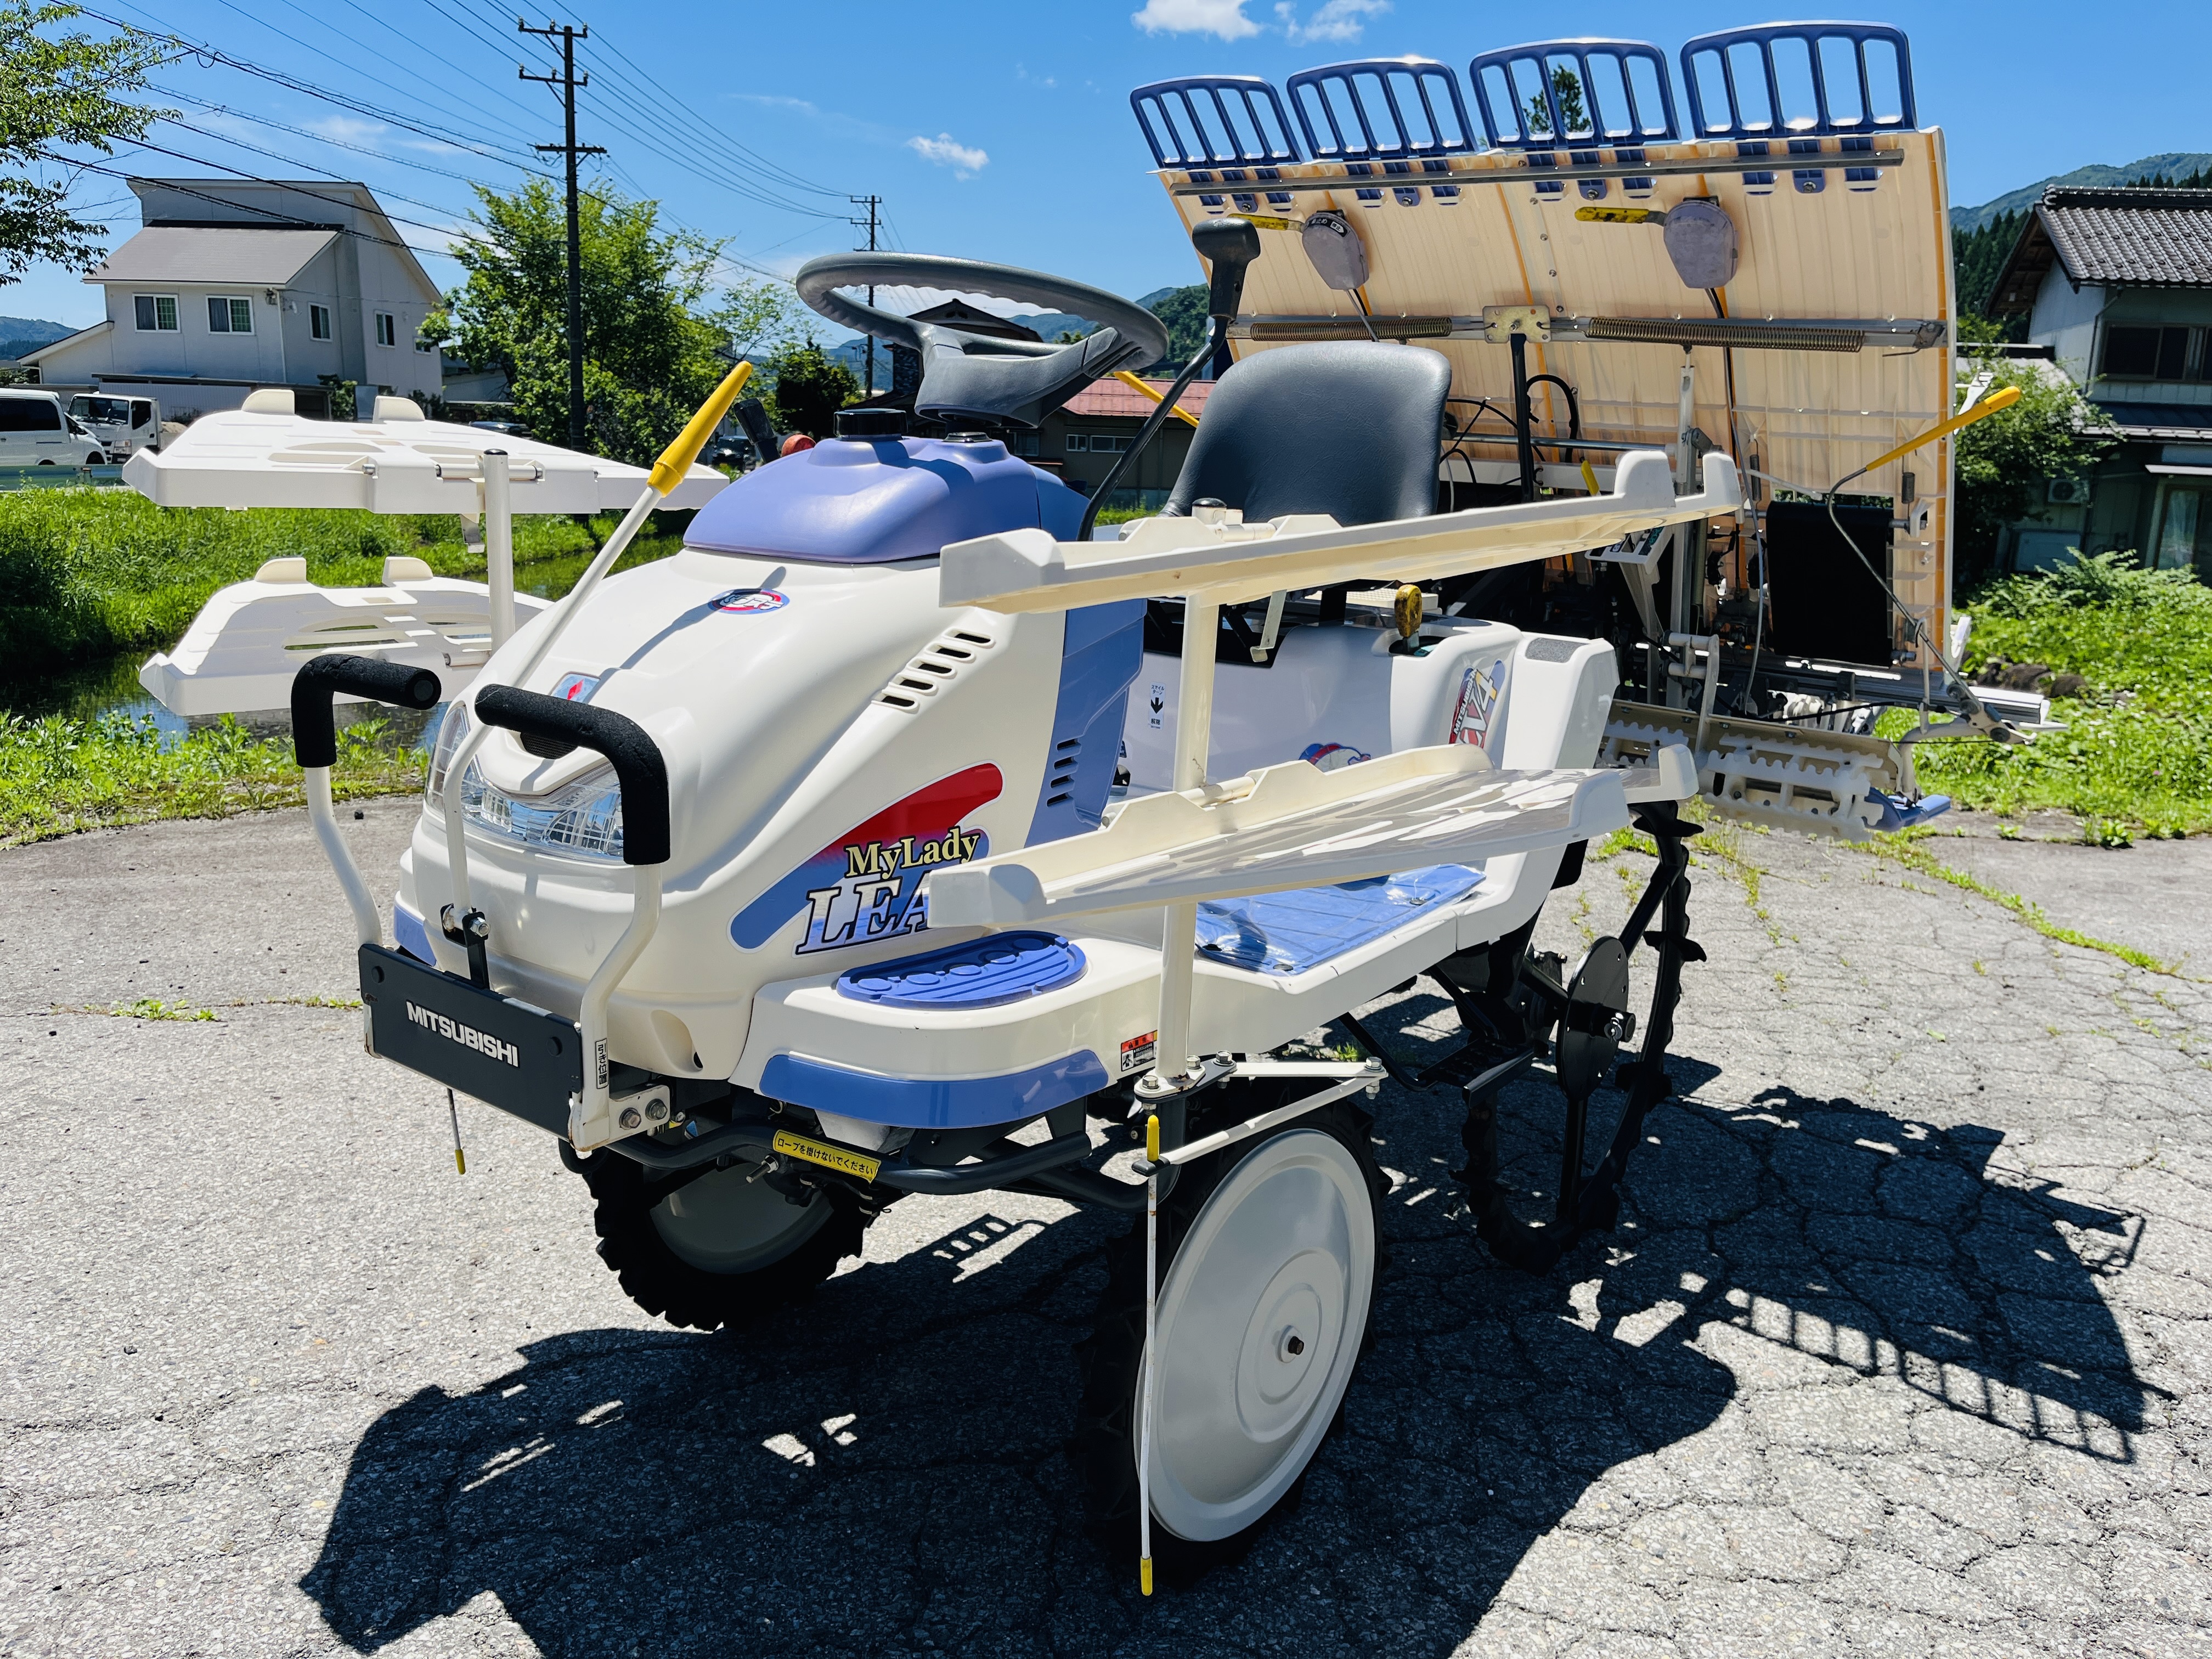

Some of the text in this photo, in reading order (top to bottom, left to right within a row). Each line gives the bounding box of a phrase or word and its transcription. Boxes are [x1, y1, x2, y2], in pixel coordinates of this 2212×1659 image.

[1453, 668, 1477, 734] MITSUBISHI
[845, 827, 980, 879] MyLady
[405, 1001, 519, 1068] MITSUBISHI
[777, 1138, 873, 1175] ロープを掛けないでください
